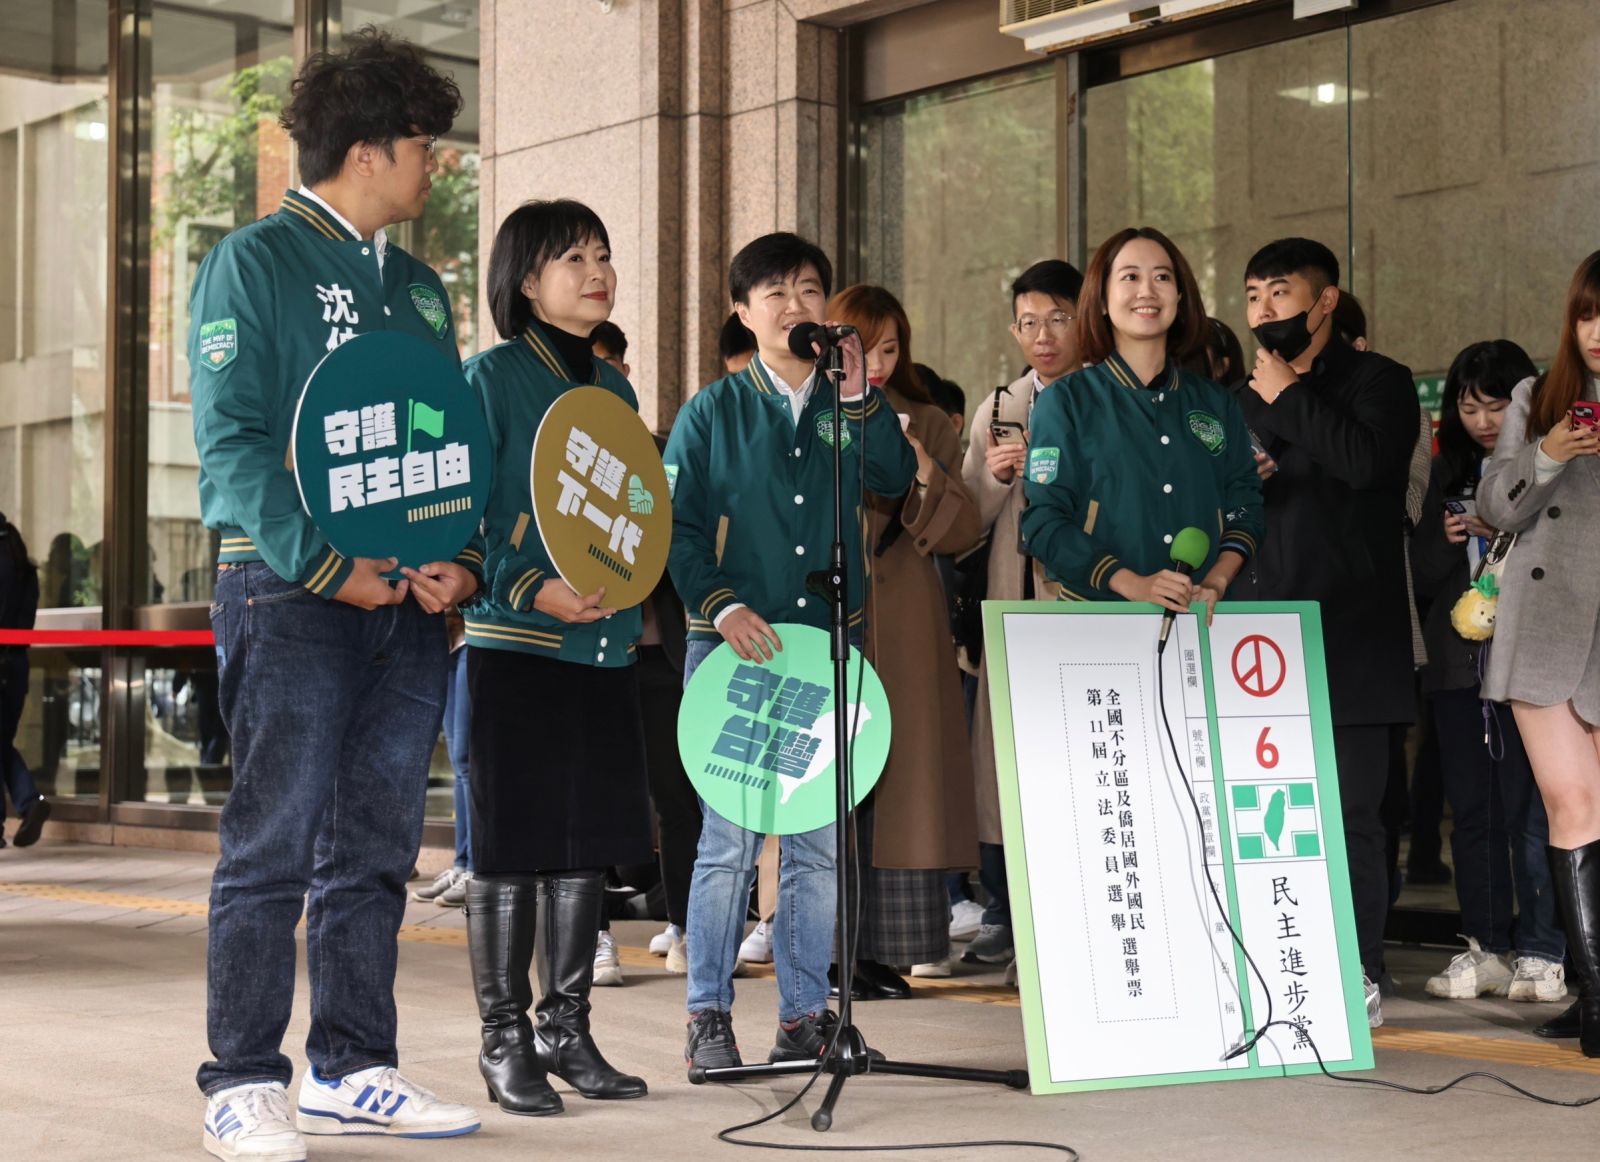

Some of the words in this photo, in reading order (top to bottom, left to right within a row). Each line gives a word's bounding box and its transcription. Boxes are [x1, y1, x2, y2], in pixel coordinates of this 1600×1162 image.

[324, 402, 397, 456] 守護
[566, 426, 627, 500] 守護
[329, 442, 471, 513] 民主自由
[556, 470, 643, 565] 下一代
[727, 663, 831, 730] 守護
[712, 714, 822, 780] 台灣
[1256, 726, 1280, 769] 6
[1106, 688, 1145, 930] 全國不分區及僑居國外國民
[1122, 937, 1142, 998] 選舉票
[1272, 876, 1315, 1051] 民主進步黨
